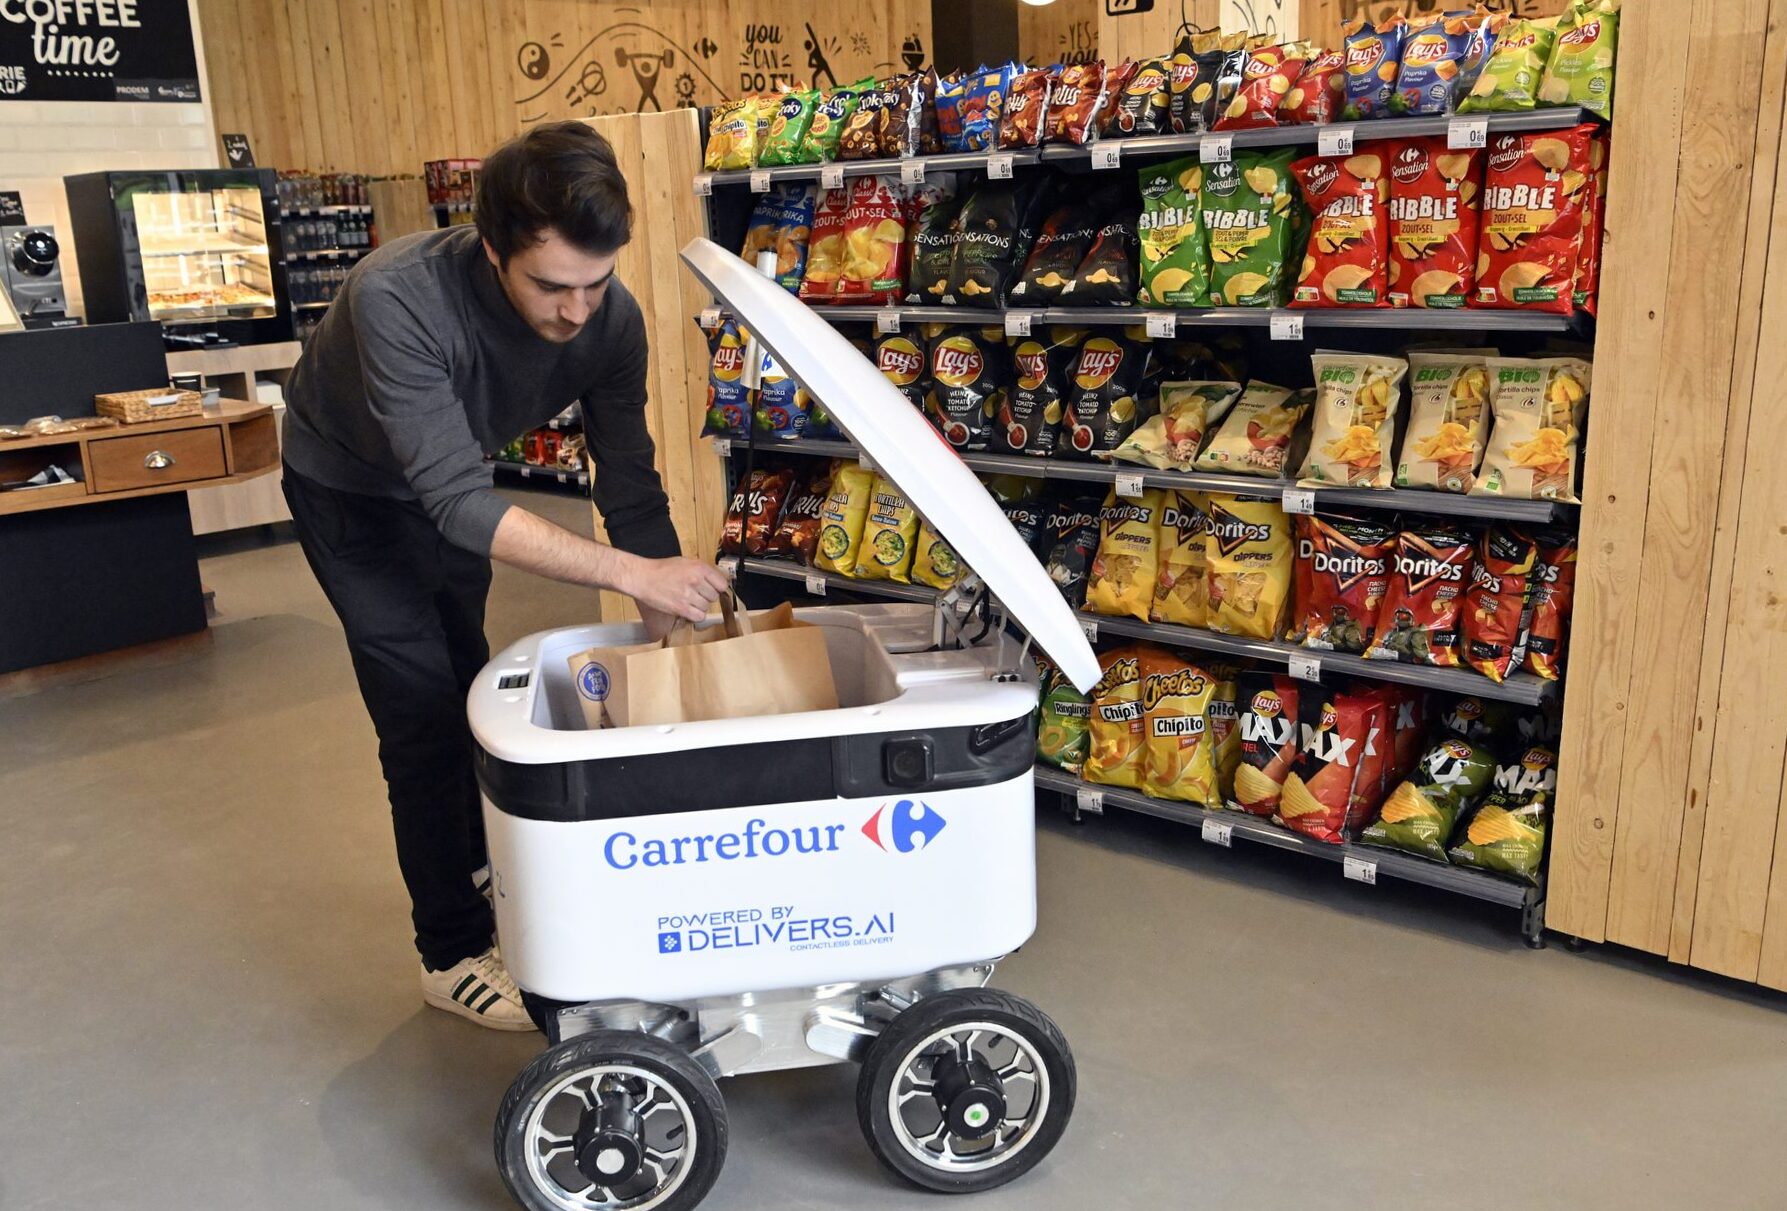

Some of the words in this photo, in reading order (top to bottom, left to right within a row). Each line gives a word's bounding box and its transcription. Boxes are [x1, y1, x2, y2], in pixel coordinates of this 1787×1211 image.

[31, 24, 120, 66] time
[745, 23, 783, 54] you
[1069, 21, 1092, 49] YES
[754, 50, 779, 69] CAN
[1346, 42, 1383, 66] Lay's
[1404, 41, 1448, 64] Lay's
[741, 72, 766, 93] DO
[1391, 160, 1429, 178] Sensation
[1488, 150, 1524, 167] Sensation
[1205, 176, 1241, 192] Sensation
[880, 348, 921, 374] Lay's
[936, 348, 979, 376] Lay's
[1077, 350, 1119, 377] Lay's
[1320, 369, 1356, 384] BIO
[1416, 369, 1452, 382] BIO
[1499, 370, 1541, 384] BIO
[1100, 505, 1151, 522] Doritos
[1205, 518, 1270, 540] Doritos
[1315, 552, 1386, 575] Doritos
[1144, 669, 1207, 710] Cheetos
[1254, 696, 1281, 712] Lay's
[1157, 716, 1203, 736] Chipito
[603, 818, 846, 870] Carrefour
[658, 908, 763, 930] POWERED
[771, 906, 794, 920] BY
[688, 912, 894, 951] DELIVERS.AI
[790, 941, 850, 951] CONTACTLESS
[853, 936, 893, 946] DELIVERY
